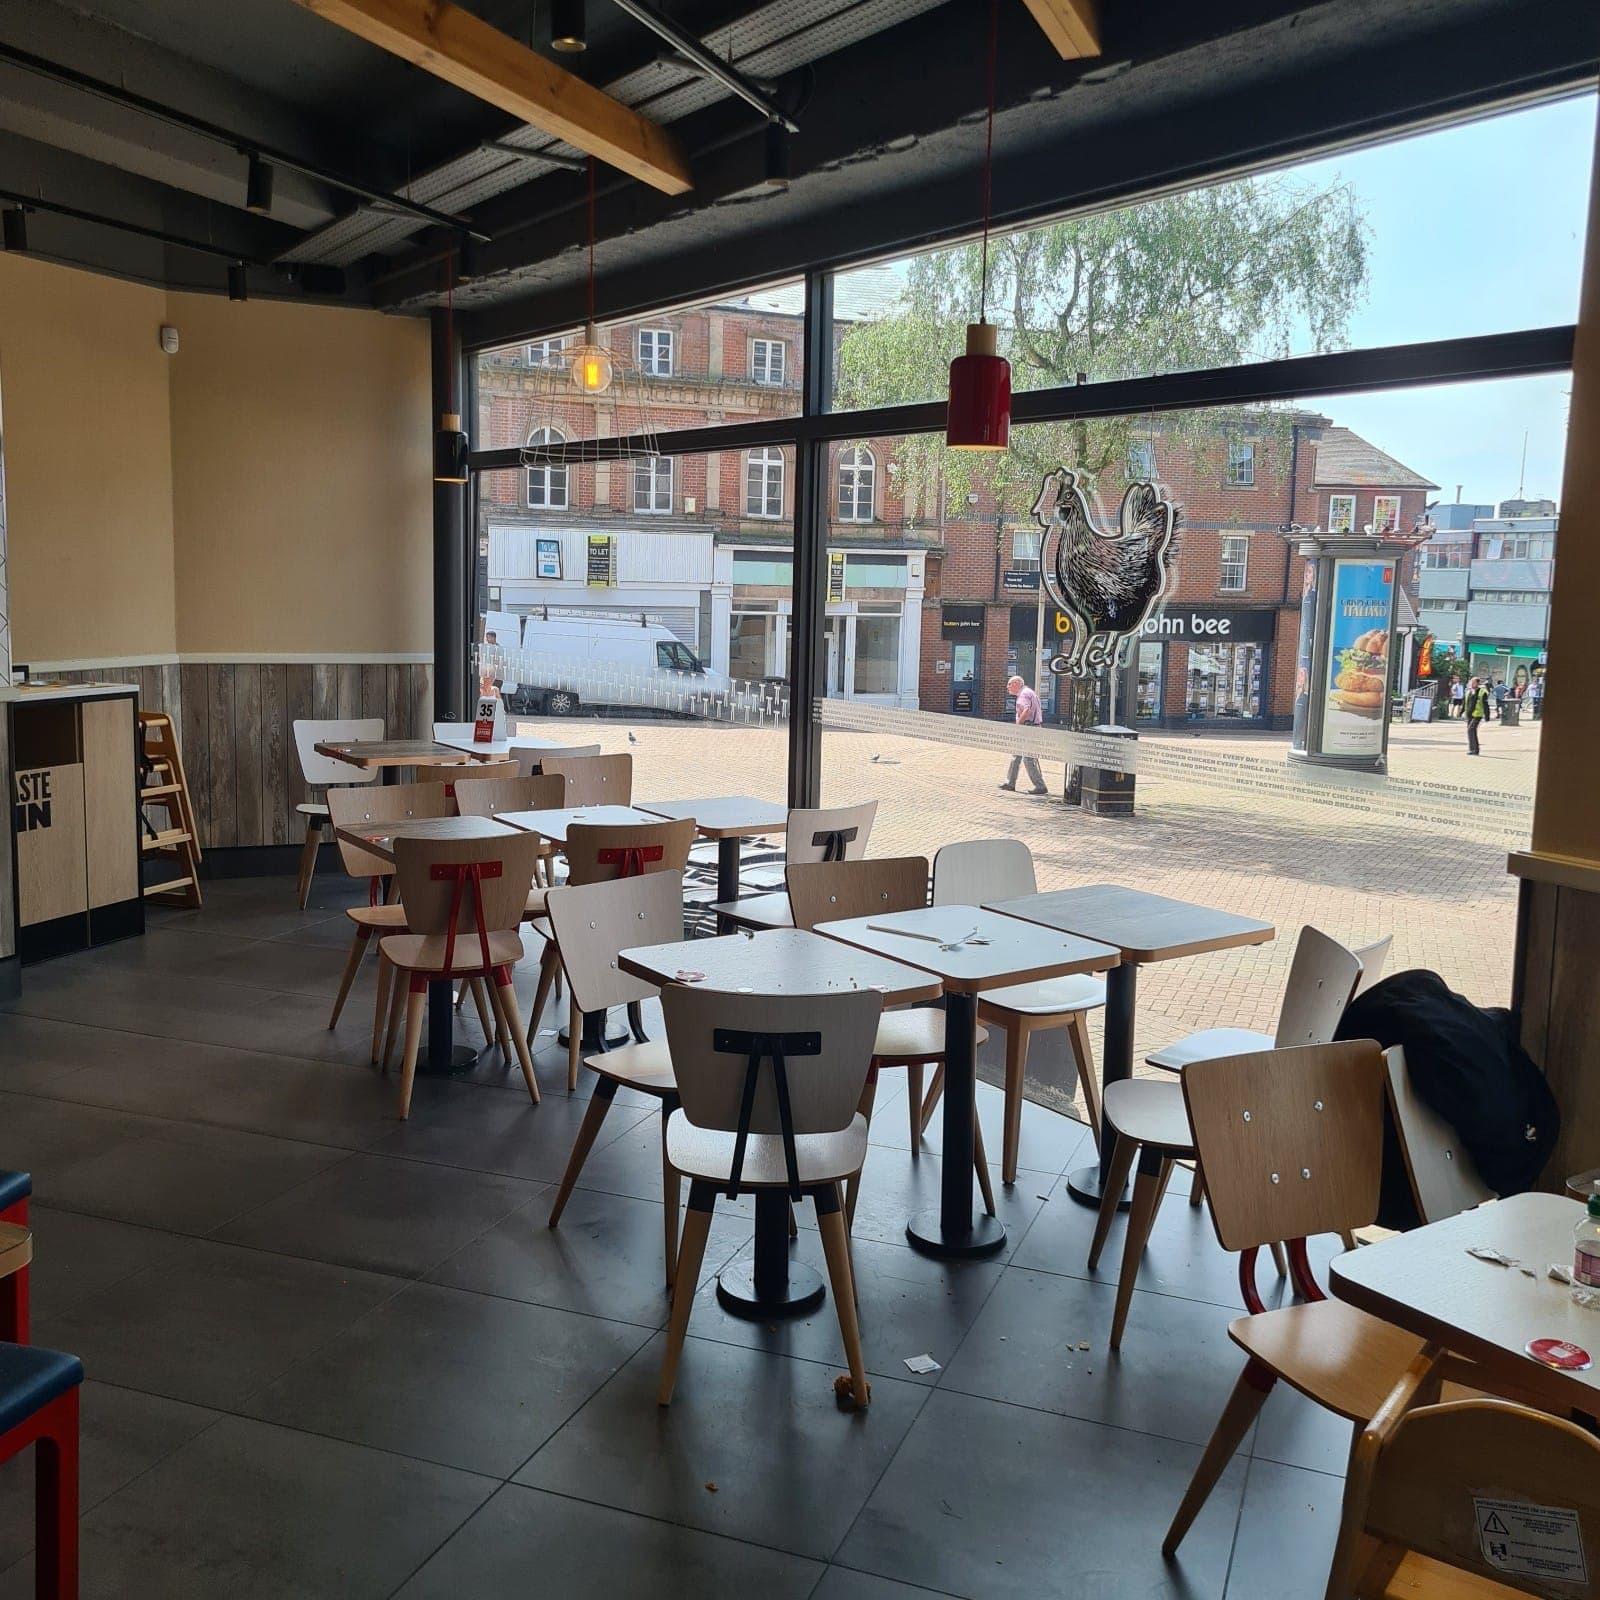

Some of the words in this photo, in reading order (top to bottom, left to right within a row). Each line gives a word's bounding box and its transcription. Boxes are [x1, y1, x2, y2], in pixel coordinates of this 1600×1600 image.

[1343, 606, 1387, 617] ITALIANO
[1191, 612, 1231, 635] bee
[480, 703, 493, 717] 35
[1161, 752, 1185, 760] COOKED
[1187, 756, 1215, 765] CHICKEN
[1239, 764, 1263, 772] SINGLE
[1194, 765, 1216, 773] SPICES
[1255, 782, 1284, 790] TASTING
[1423, 782, 1457, 791] COOKED
[1460, 787, 1501, 798] CHICKEN
[1502, 793, 1531, 802] EVERY
[1292, 787, 1330, 797] FRESHEST
[1332, 794, 1366, 803] CHICKEN
[1422, 791, 1449, 799] HERBS
[1473, 798, 1504, 807] SPICES
[1334, 802, 1370, 812] BREADED
[1431, 818, 1460, 826] COOKS
